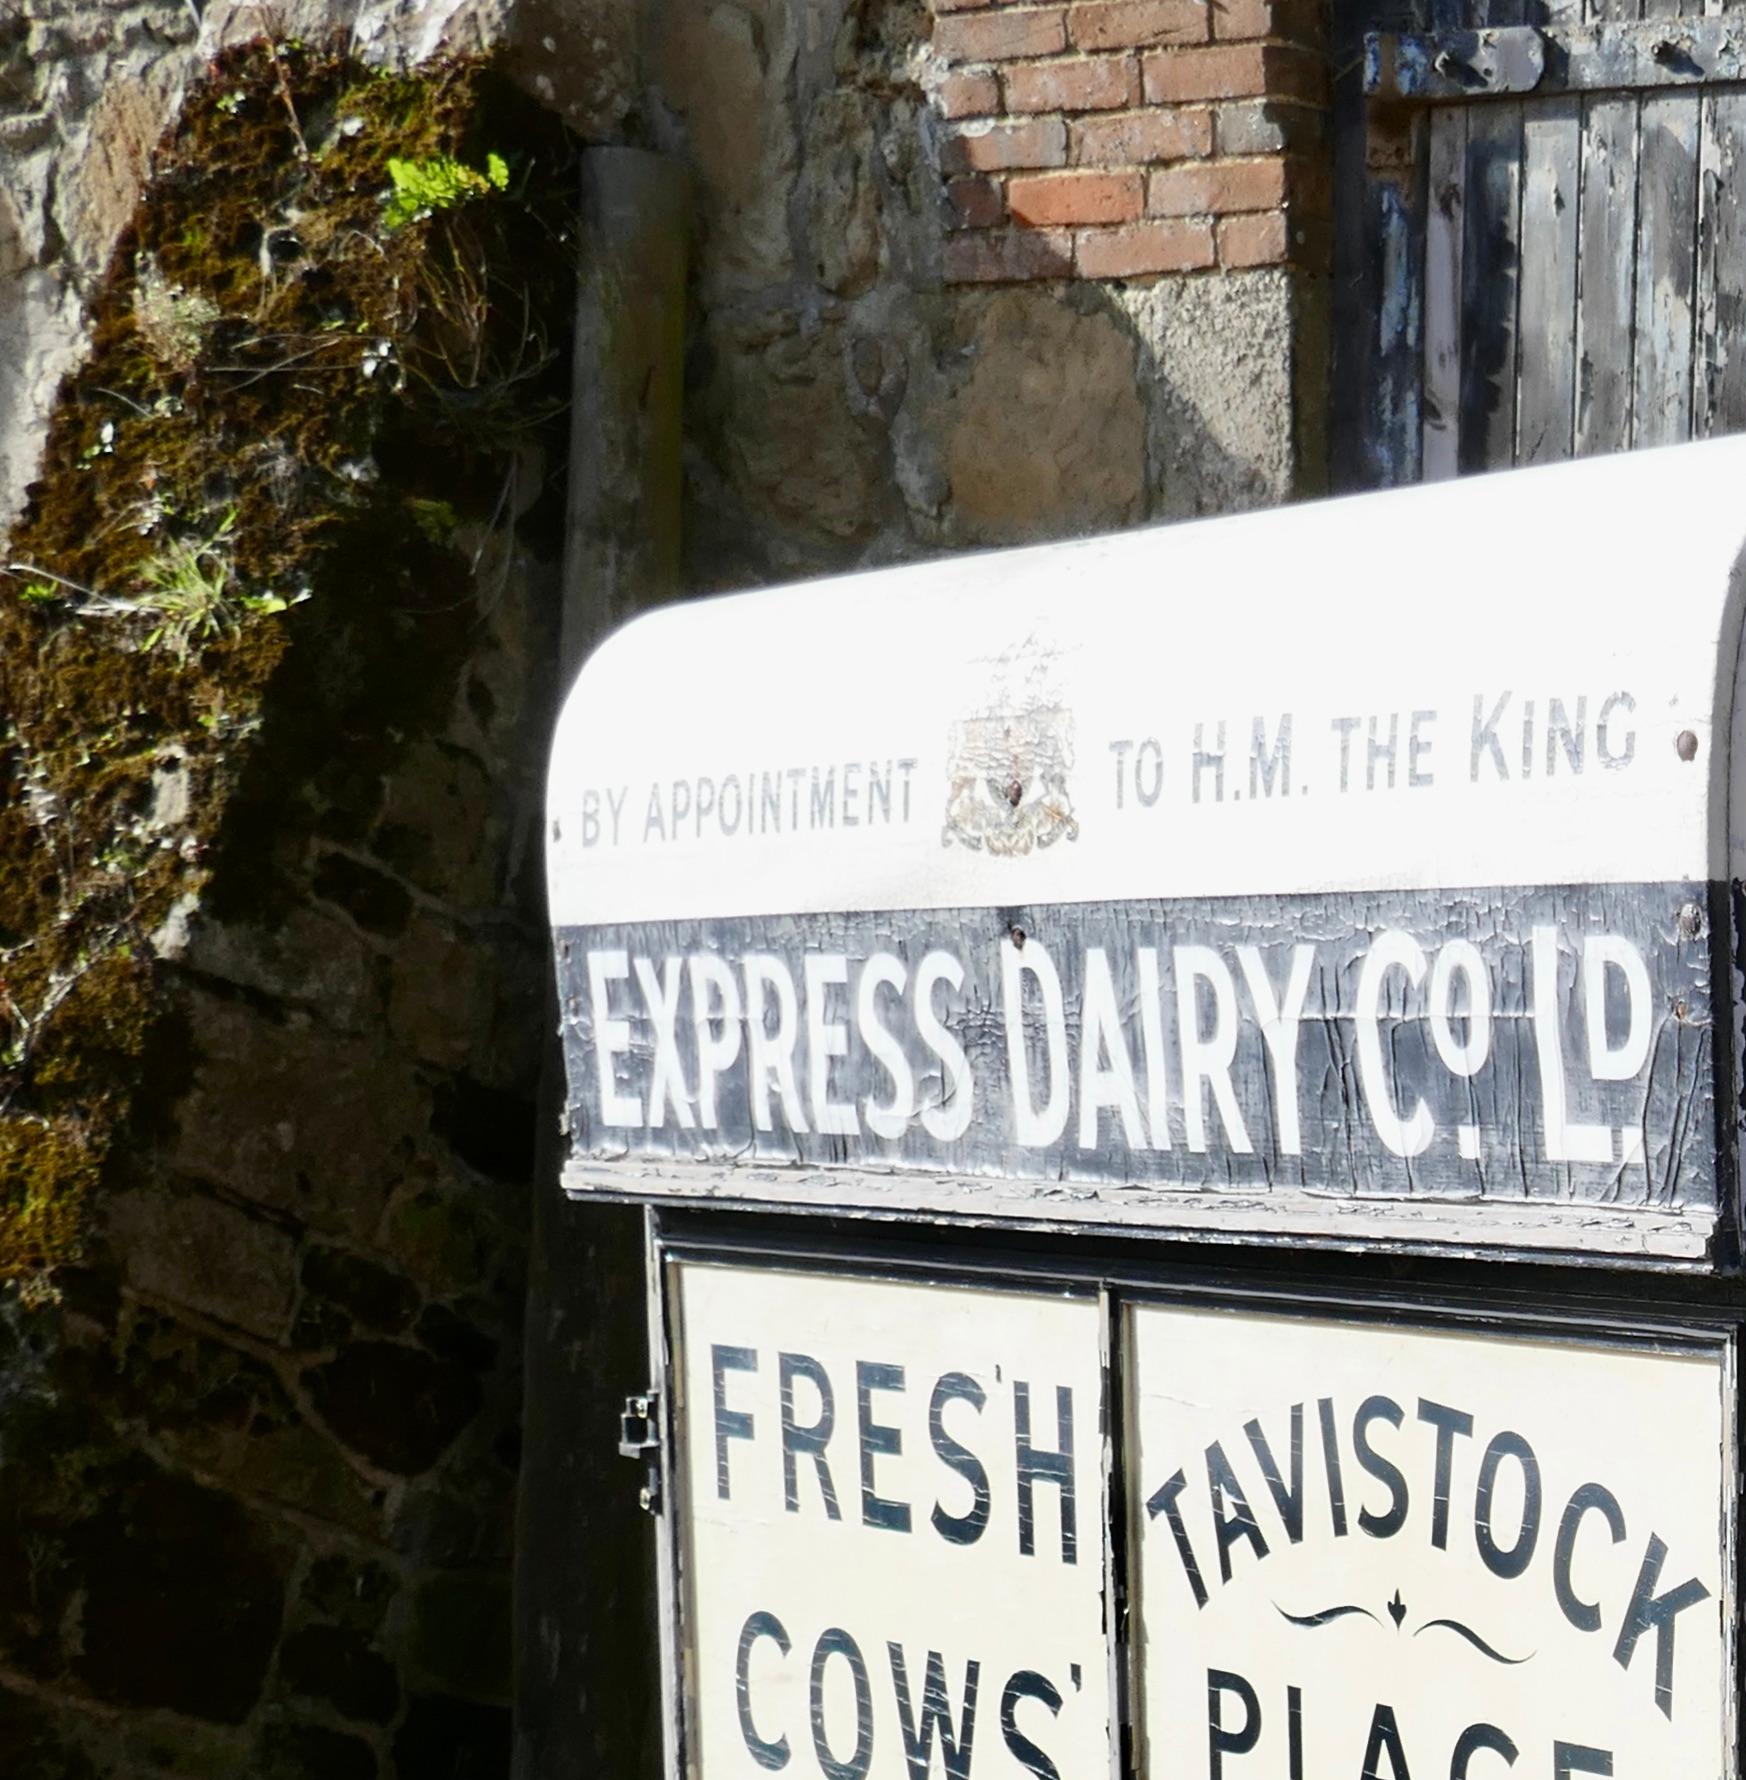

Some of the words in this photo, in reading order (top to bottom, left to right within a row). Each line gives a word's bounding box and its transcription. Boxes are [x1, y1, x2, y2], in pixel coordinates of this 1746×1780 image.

[581, 786, 628, 847] BY
[643, 757, 918, 843] APPOINTMENT
[1108, 738, 1164, 809] TO
[1192, 712, 1308, 804] H.M.
[1331, 710, 1437, 793] THE
[1469, 690, 1636, 783] KING
[587, 949, 974, 1143] EXPRESS
[1000, 938, 1316, 1156] DAIRY
[710, 1343, 1078, 1565] FRESH
[1146, 1395, 1711, 1722] TAVISTOCK
